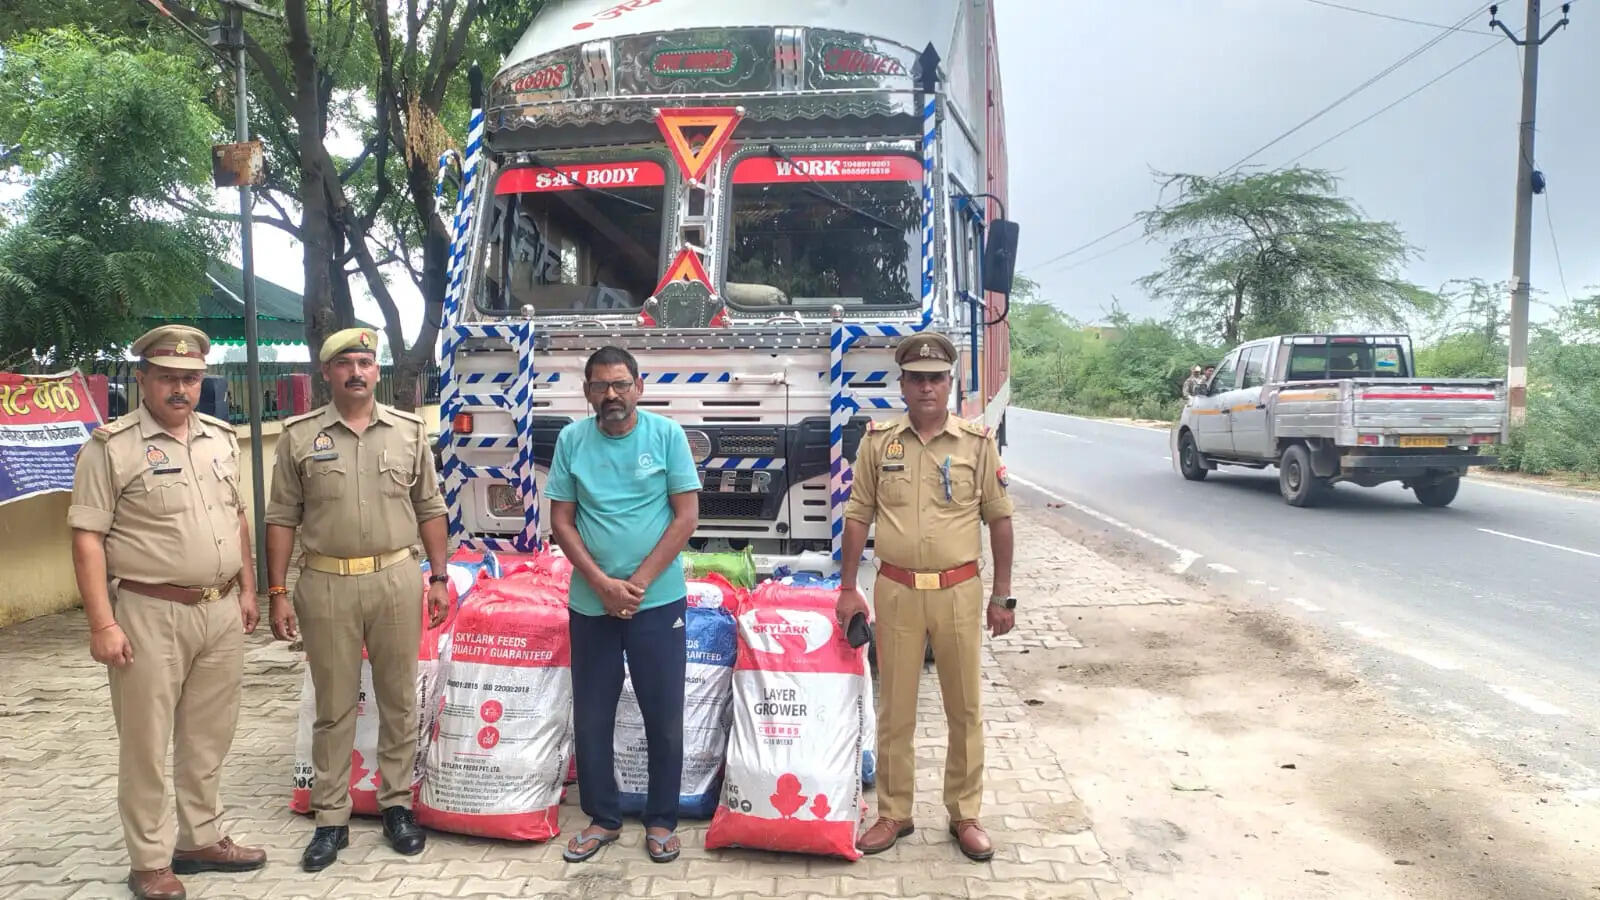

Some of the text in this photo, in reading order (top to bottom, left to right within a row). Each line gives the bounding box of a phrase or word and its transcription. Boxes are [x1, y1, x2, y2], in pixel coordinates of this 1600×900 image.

[586, 167, 640, 185] BODY
[776, 160, 840, 176] WORK
[753, 624, 809, 634] SKYLARK
[455, 632, 527, 648] SKYLARK FEEDS
[451, 644, 553, 661] QUALITY GUARANTEED
[763, 688, 796, 701] LAYER
[754, 703, 807, 716] GROWER
